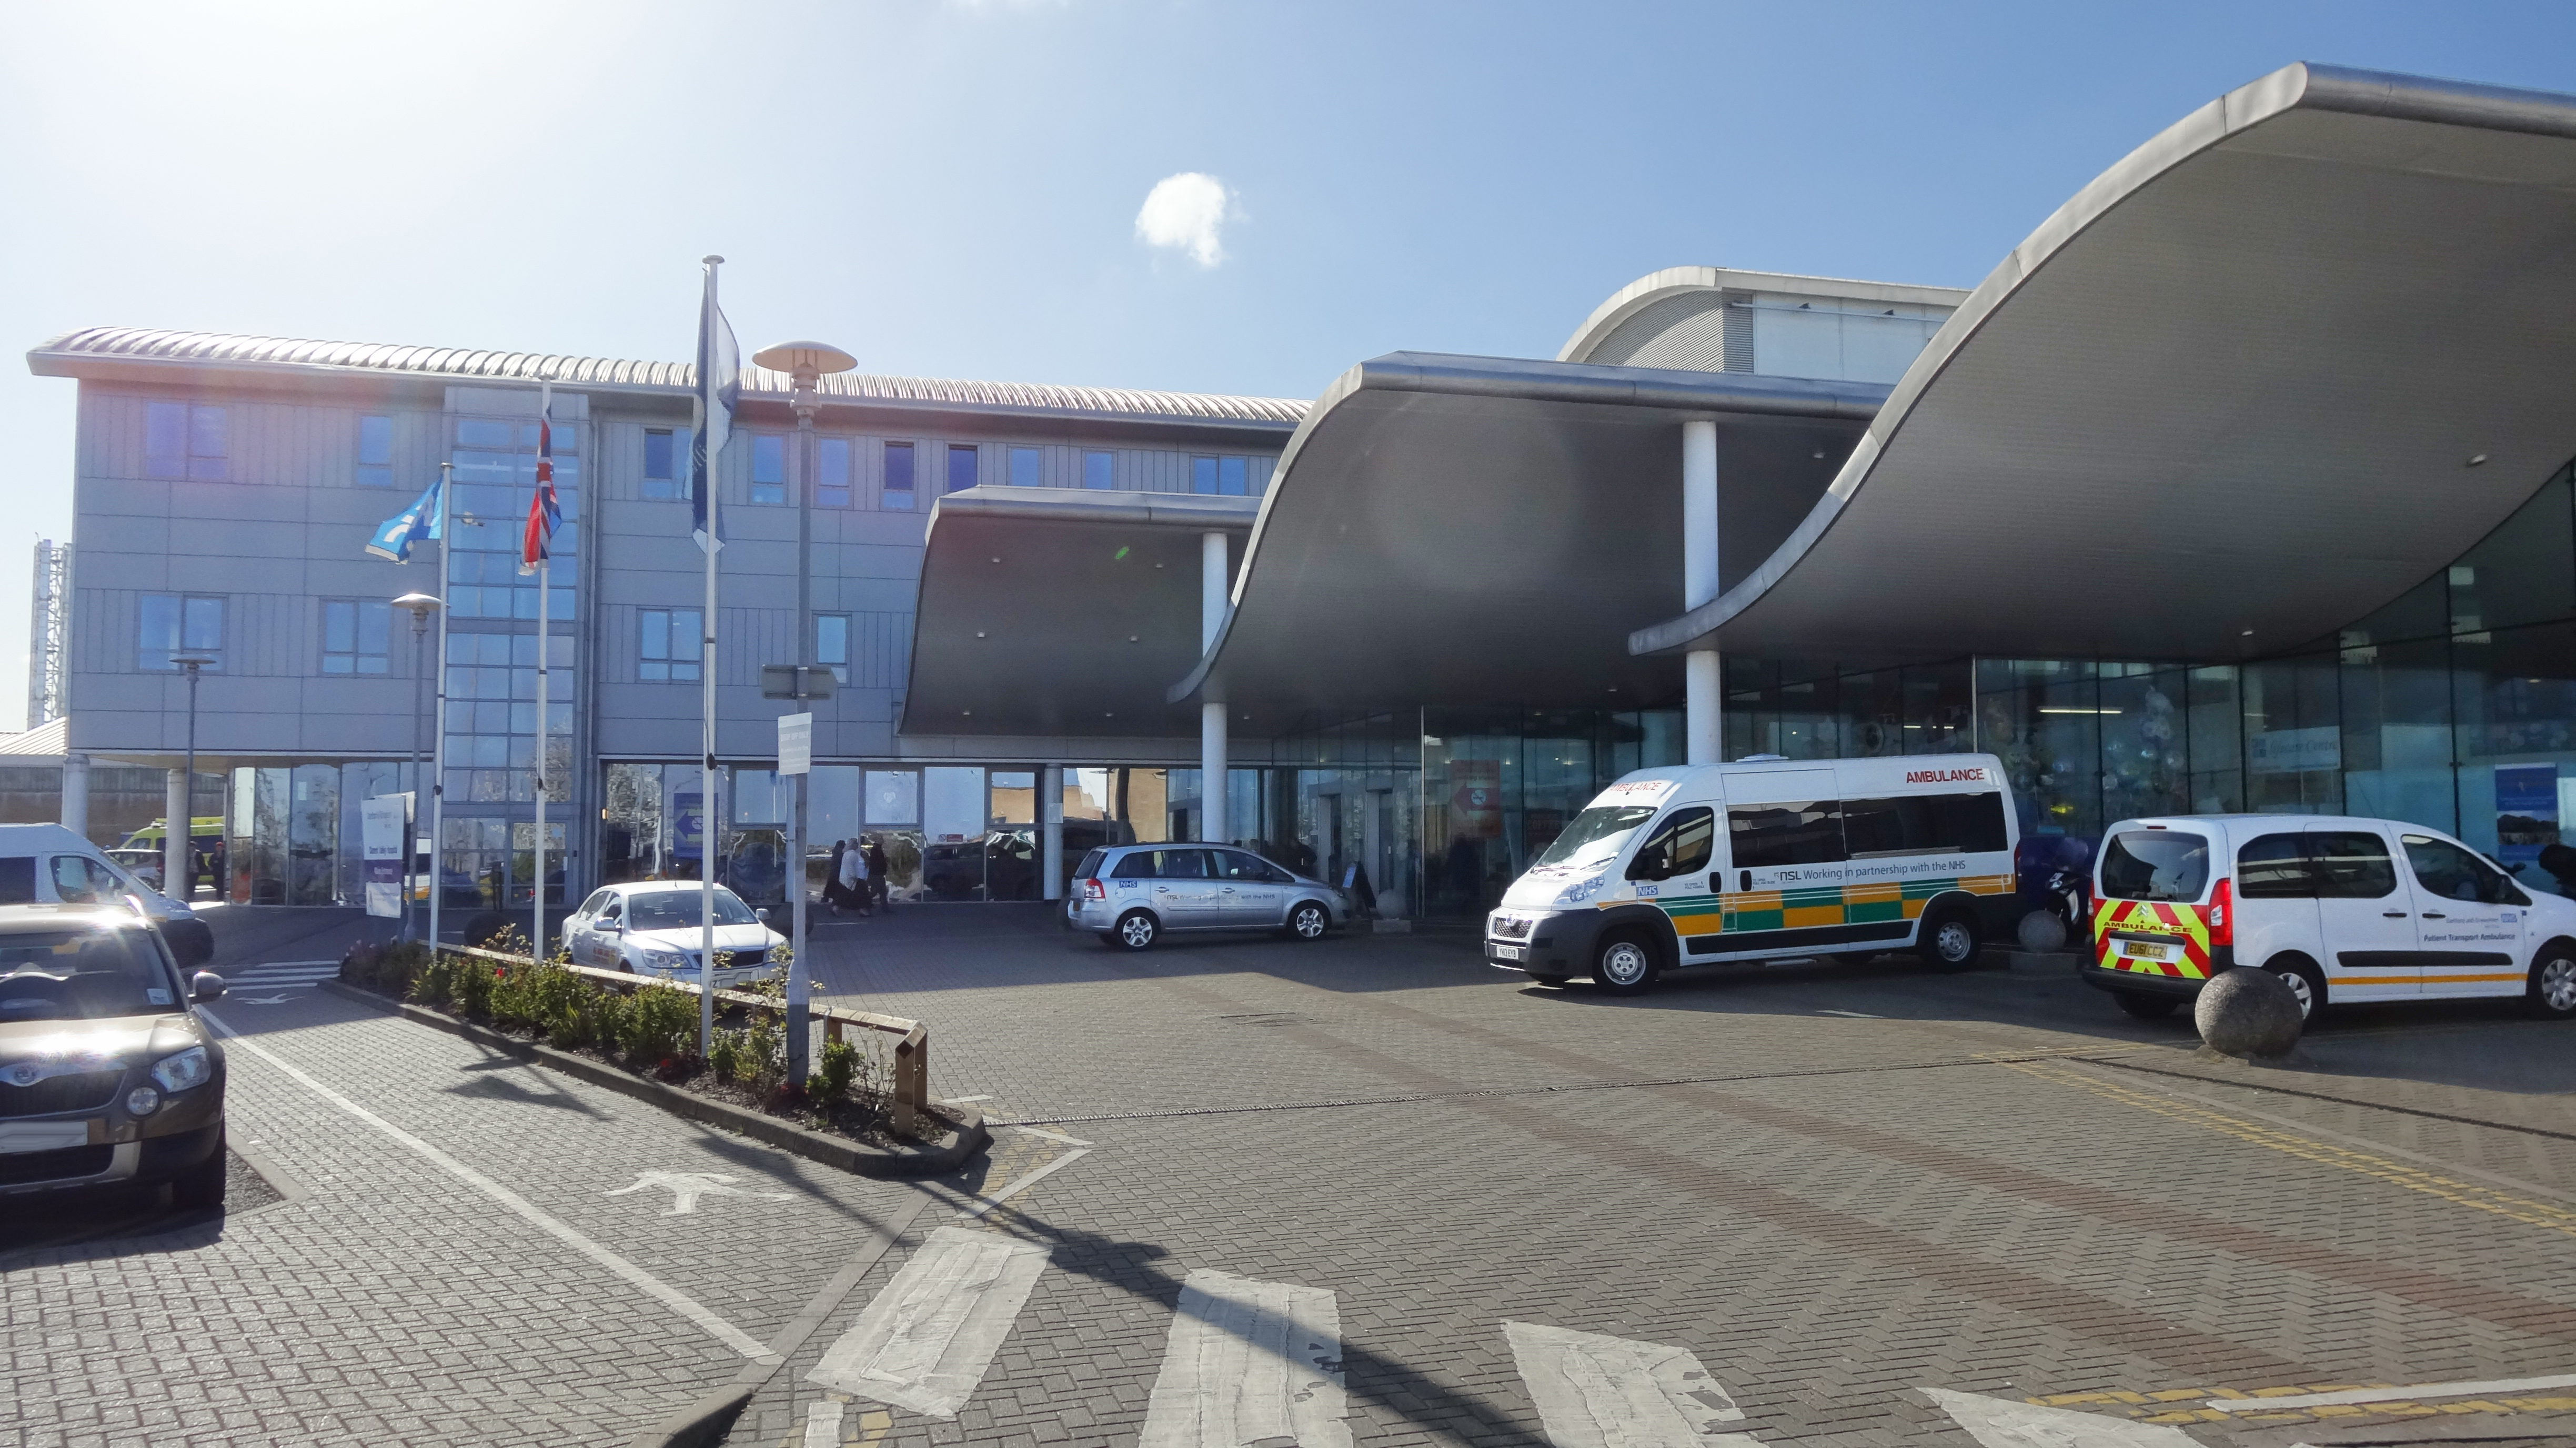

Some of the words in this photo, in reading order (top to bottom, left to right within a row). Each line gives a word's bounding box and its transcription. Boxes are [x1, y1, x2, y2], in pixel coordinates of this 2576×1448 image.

[1906, 768, 1985, 783] AMBULANCE
[1609, 782, 1662, 792] AMBULANCE
[1803, 869, 1842, 880] Working
[1845, 869, 1853, 877] in
[1856, 863, 1908, 878] partnership
[1910, 861, 1930, 873] with
[1931, 861, 1947, 871] the
[1948, 860, 1966, 869] NHS
[1637, 886, 1657, 896] NHS
[2448, 934, 2479, 942] Transport
[2129, 943, 2147, 956] EU61
[2147, 945, 2164, 958] CCZ
